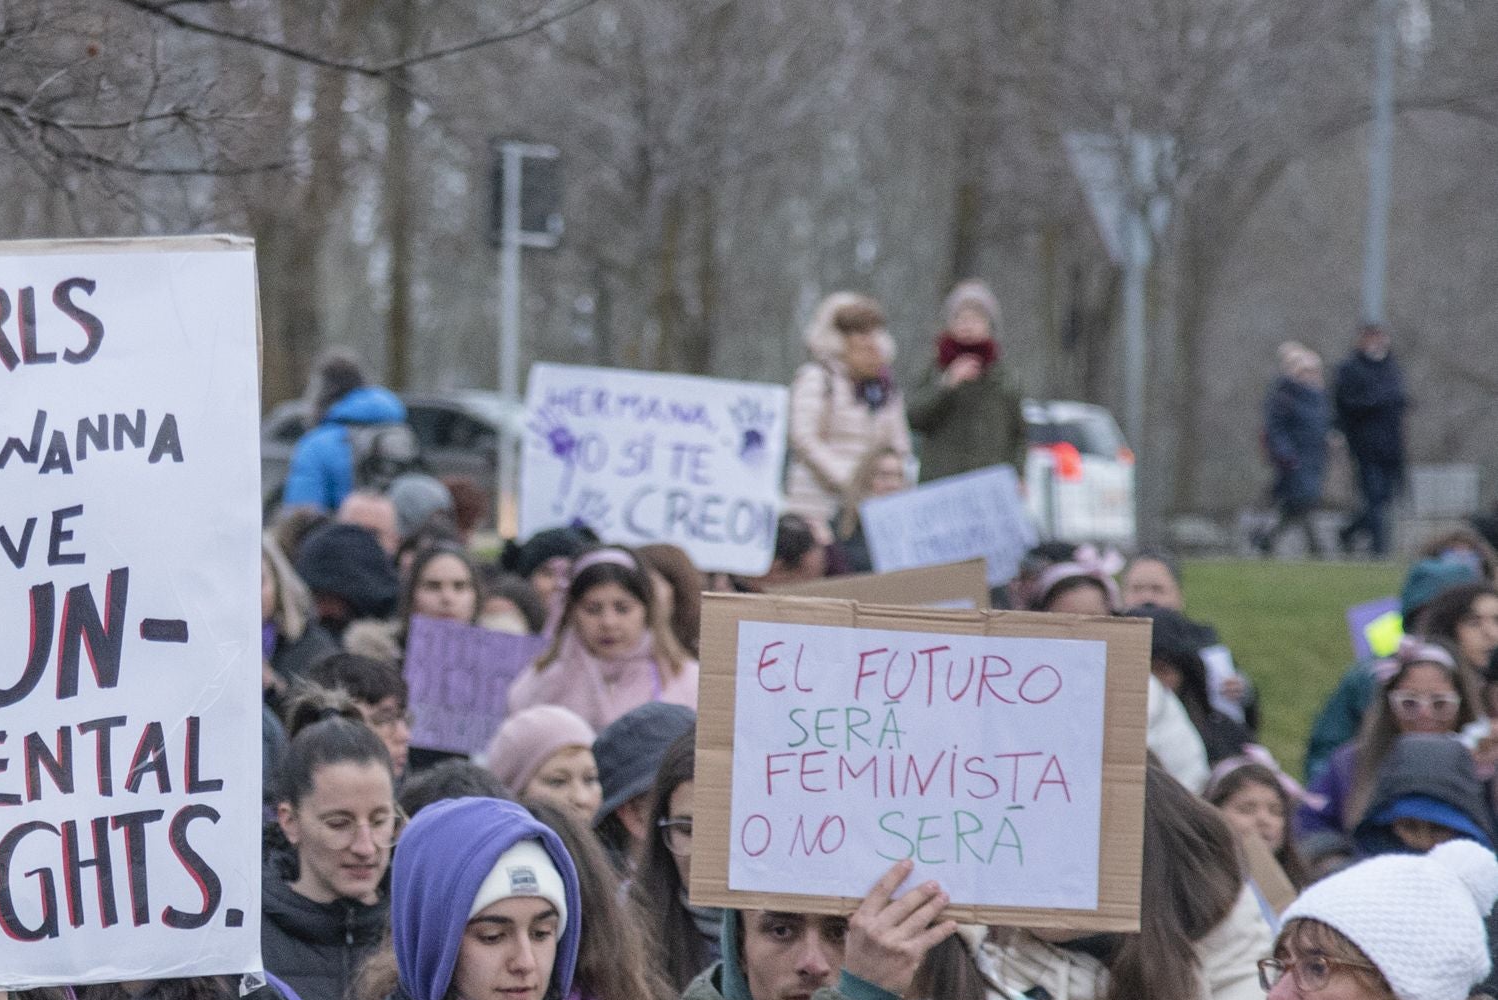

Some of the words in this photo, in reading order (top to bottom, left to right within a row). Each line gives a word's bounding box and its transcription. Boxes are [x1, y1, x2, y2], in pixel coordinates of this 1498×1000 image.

[668, 440, 713, 486] TE
[757, 641, 812, 693] EL
[855, 646, 1062, 707] FUTURO
[741, 814, 772, 857] O
[789, 815, 845, 857] NO
